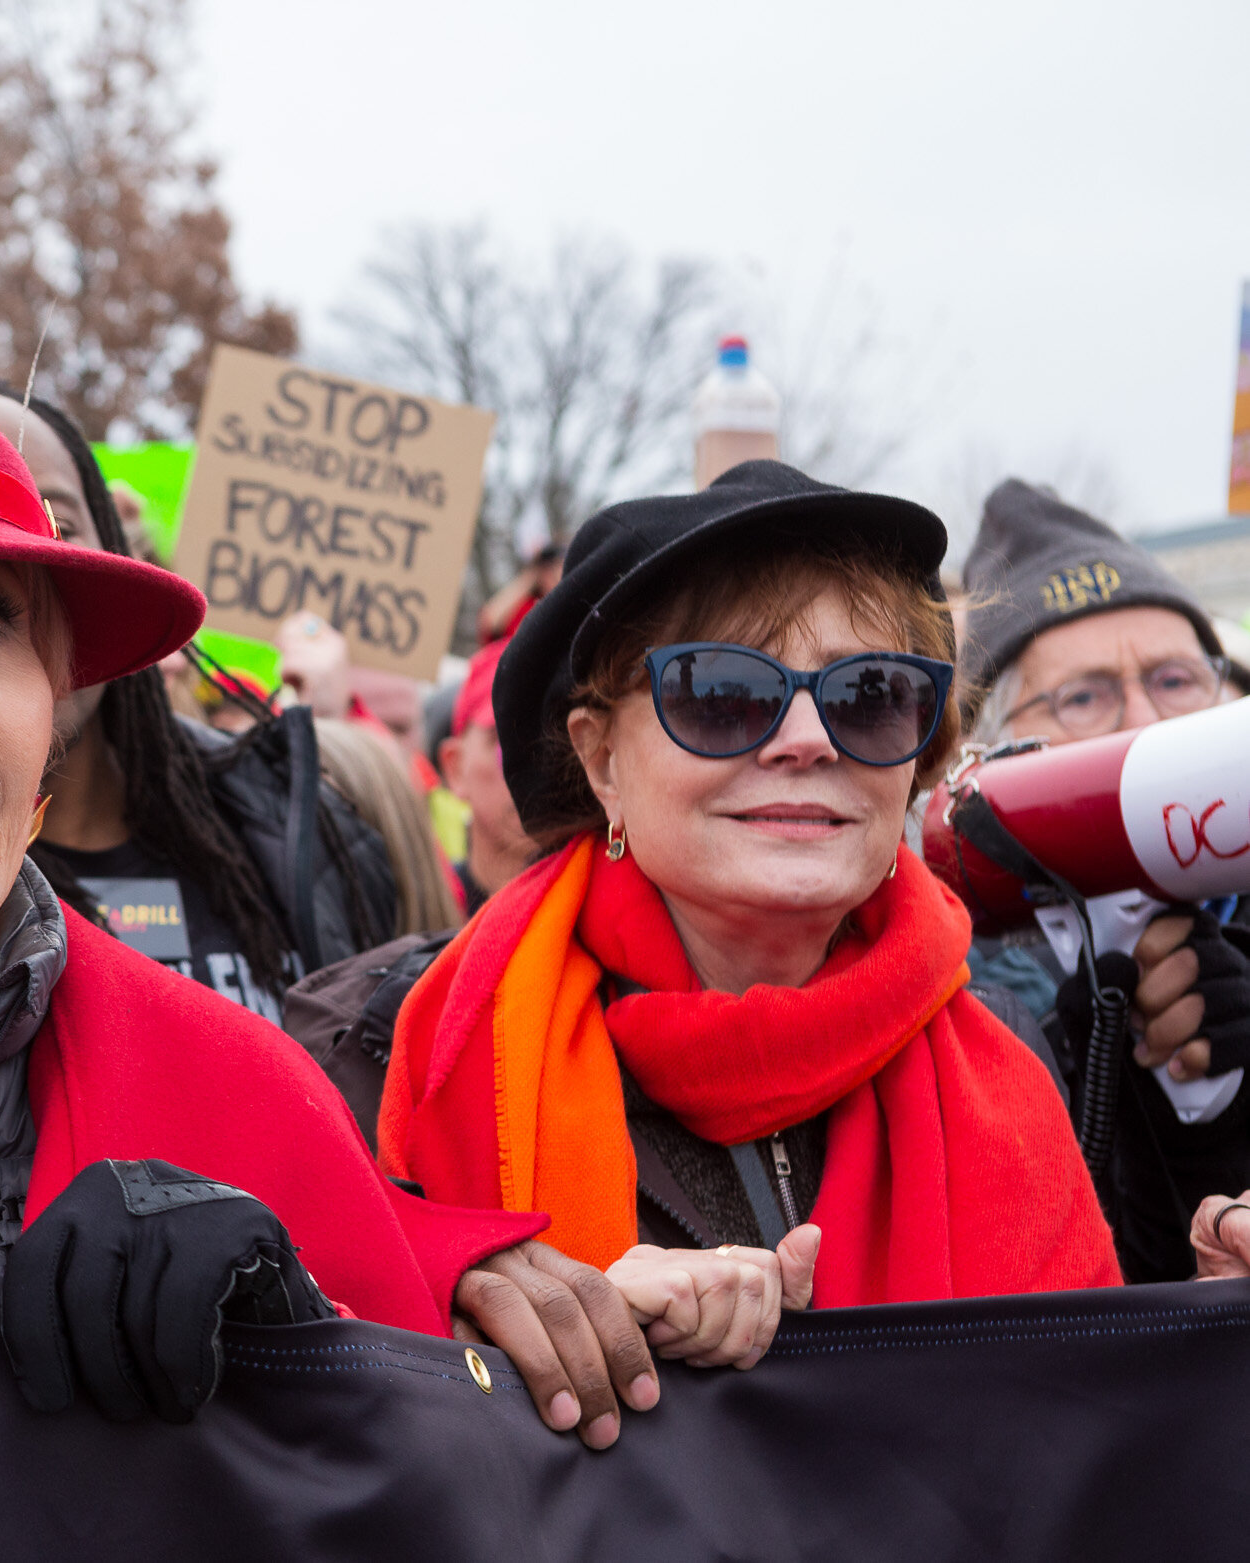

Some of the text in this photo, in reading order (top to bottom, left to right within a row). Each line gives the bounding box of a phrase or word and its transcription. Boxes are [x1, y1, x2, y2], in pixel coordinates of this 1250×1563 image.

[264, 367, 432, 452] STOP
[226, 478, 432, 574] FOREST
[205, 539, 430, 658] BIOMASS
[121, 904, 181, 926] DRILL
